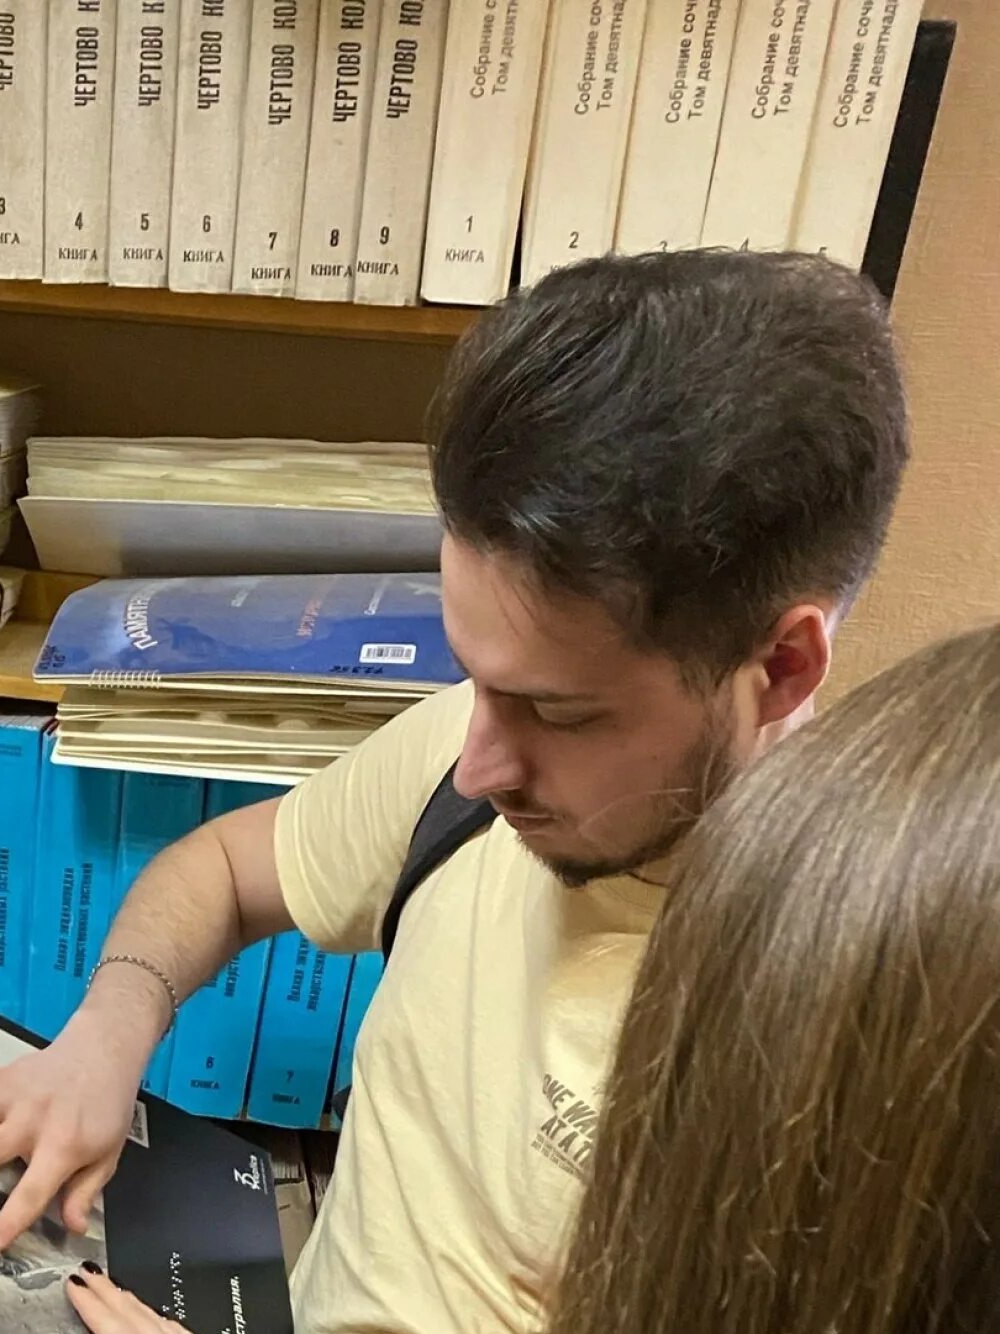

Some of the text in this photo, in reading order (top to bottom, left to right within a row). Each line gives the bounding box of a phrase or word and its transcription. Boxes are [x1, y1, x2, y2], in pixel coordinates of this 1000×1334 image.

[74, 25, 100, 107] ЧЕРТОВО
[138, 25, 164, 107] ЧЕРТОВО
[470, 13, 495, 99] Собрание
[197, 30, 223, 111] ЧЕРТОВО
[386, 39, 418, 119] ЧЕРТОВО
[492, 62, 513, 95] Том
[574, 30, 599, 115] Собрание
[665, 37, 692, 124] Собрание
[751, 32, 780, 120] Собрание
[268, 44, 295, 126] ЧЕРТОВО
[332, 42, 363, 123] ЧЕРТОВО
[832, 41, 865, 128] Собрание
[596, 77, 615, 111] Том
[687, 85, 707, 121] Том
[773, 80, 794, 116] Том
[855, 89, 879, 126] Том
[74, 212, 84, 230] 4
[140, 213, 150, 231] 5
[202, 215, 211, 234] 6
[465, 215, 474, 233] 1
[268, 232, 278, 251] 7
[330, 229, 340, 247] 8
[379, 226, 390, 245] 9
[569, 231, 580, 249] 2
[57, 247, 99, 261] КНИГА
[123, 248, 164, 261] КНИГА
[183, 249, 225, 263] КНИГА
[445, 248, 486, 263] КНИГА
[251, 265, 292, 281] КНИГА
[310, 263, 353, 278] КНИГА
[357, 260, 400, 276] КНИГА
[206, 1057, 213, 1068] 6
[558, 1131, 579, 1153] A
